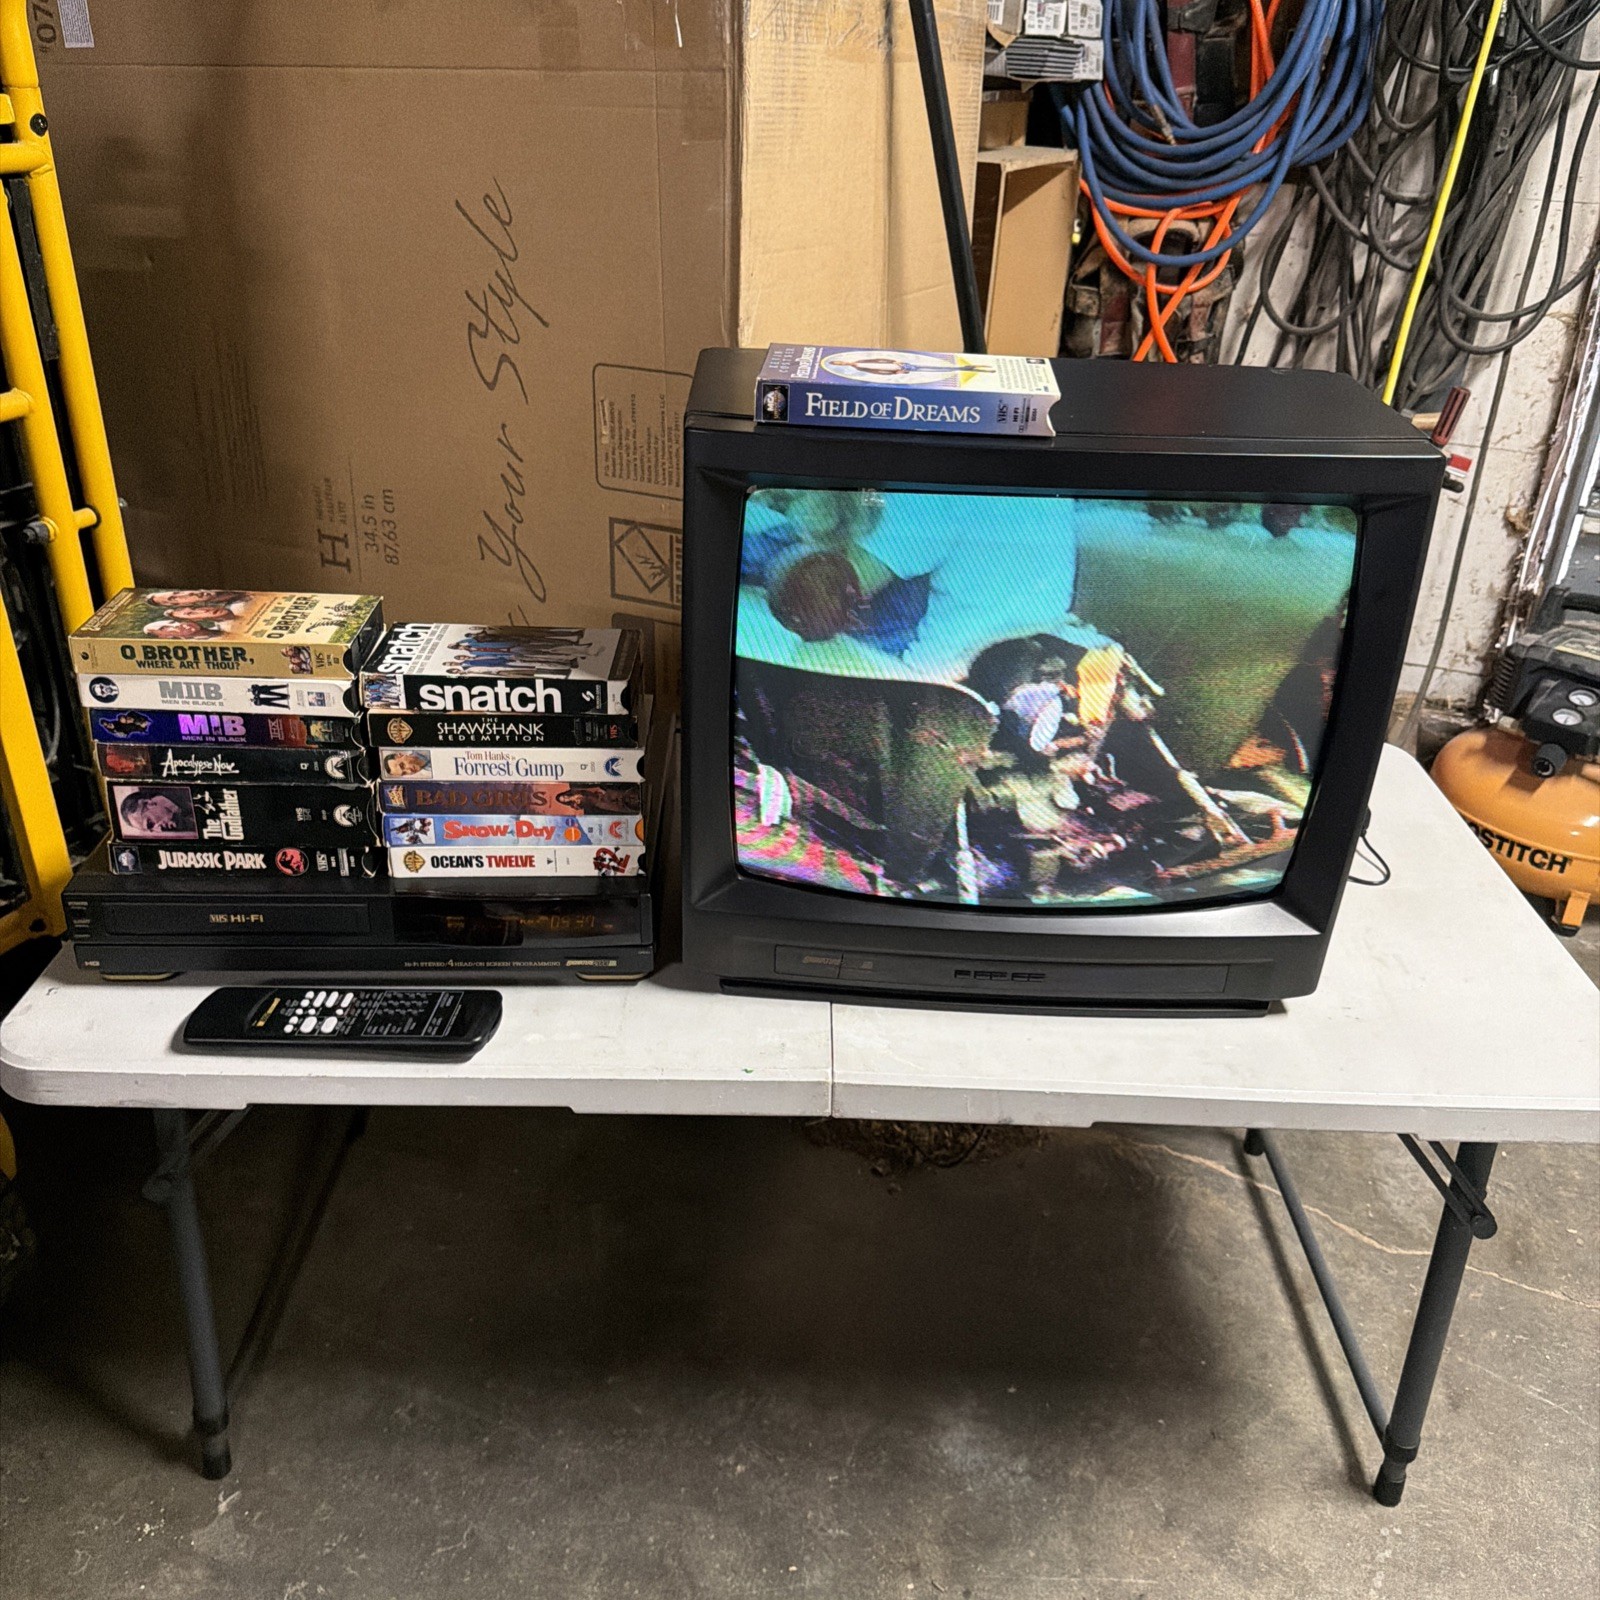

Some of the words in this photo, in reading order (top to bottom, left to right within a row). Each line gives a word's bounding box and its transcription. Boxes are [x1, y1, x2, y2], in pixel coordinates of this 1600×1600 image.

[456, 177, 549, 404] Style
[767, 393, 775, 412] MCA
[805, 392, 869, 418] FIELD
[870, 402, 892, 418] OF
[893, 396, 981, 424] DREAMS
[361, 495, 375, 510] in
[382, 490, 394, 513] cm
[477, 424, 546, 602] Your
[317, 529, 350, 574] H
[120, 645, 136, 660] O
[143, 645, 255, 665] BROTHER,
[376, 623, 433, 674] snatch
[136, 660, 176, 669] WHERE
[178, 661, 200, 669] ART
[205, 660, 241, 671] THOU?
[419, 679, 563, 713] snatch
[437, 722, 545, 735] SHAWSHANK
[162, 748, 213, 777] Apocalypse
[213, 754, 236, 772] Now
[465, 751, 483, 760] Tom
[484, 751, 510, 760] Hanks
[453, 757, 513, 777] Forrest
[515, 758, 564, 780] Gump
[415, 788, 467, 806] BAD
[473, 789, 548, 807] GIRLS
[217, 788, 244, 840] Godfather
[203, 817, 222, 839] The
[515, 820, 557, 840] Day
[158, 850, 221, 870] JURASSIC
[224, 850, 267, 870] PARK
[430, 855, 484, 869] OCEAN'S
[486, 855, 536, 868] TWELVE
